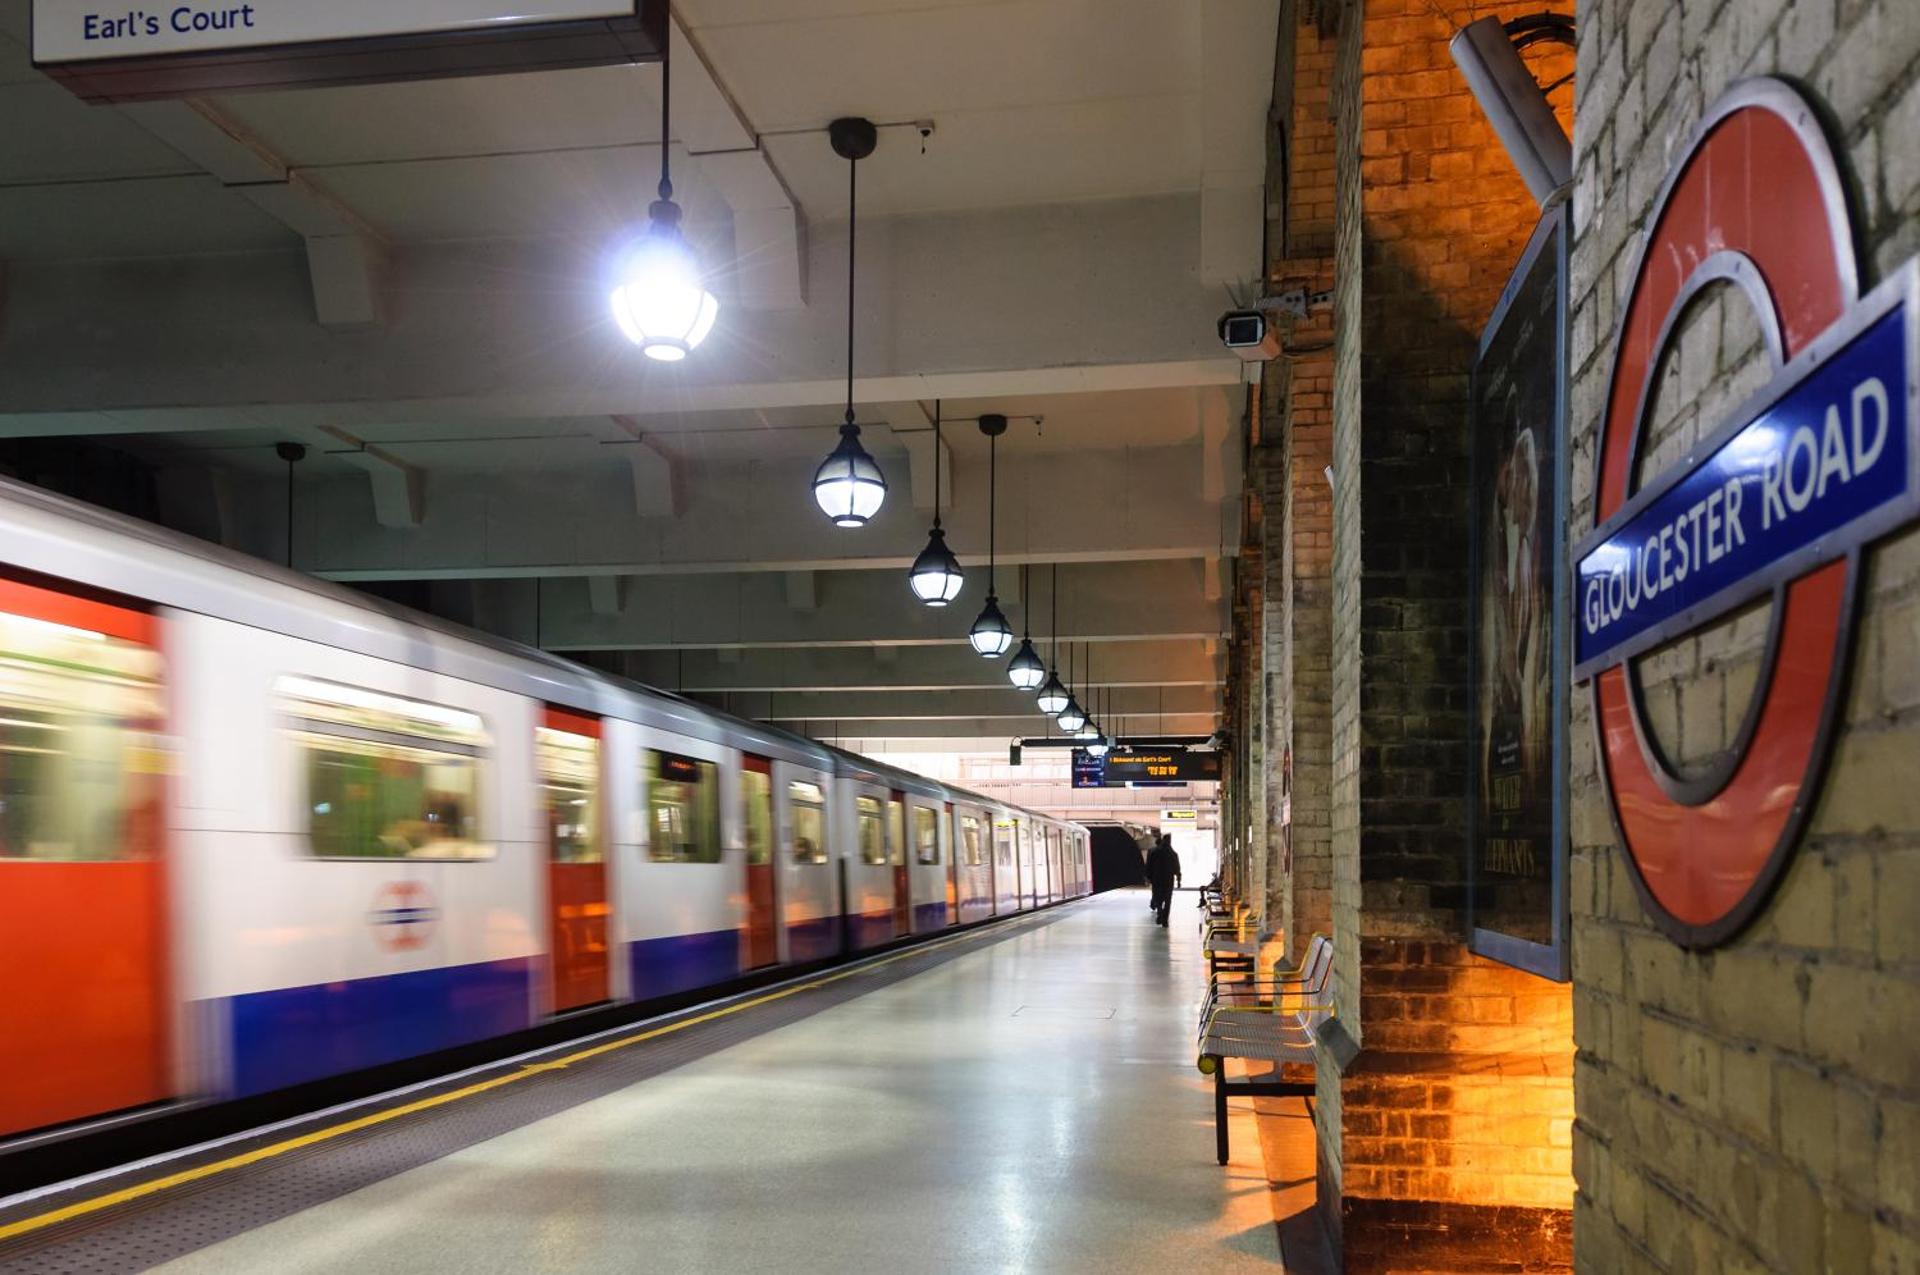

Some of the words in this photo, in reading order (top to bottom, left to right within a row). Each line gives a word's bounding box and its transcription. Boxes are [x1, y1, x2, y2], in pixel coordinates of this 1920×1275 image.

[84, 11, 160, 40] Earl's
[170, 4, 254, 33] Court
[1584, 477, 1746, 635] GLOUCESTER
[1761, 376, 1889, 530] ROAD
